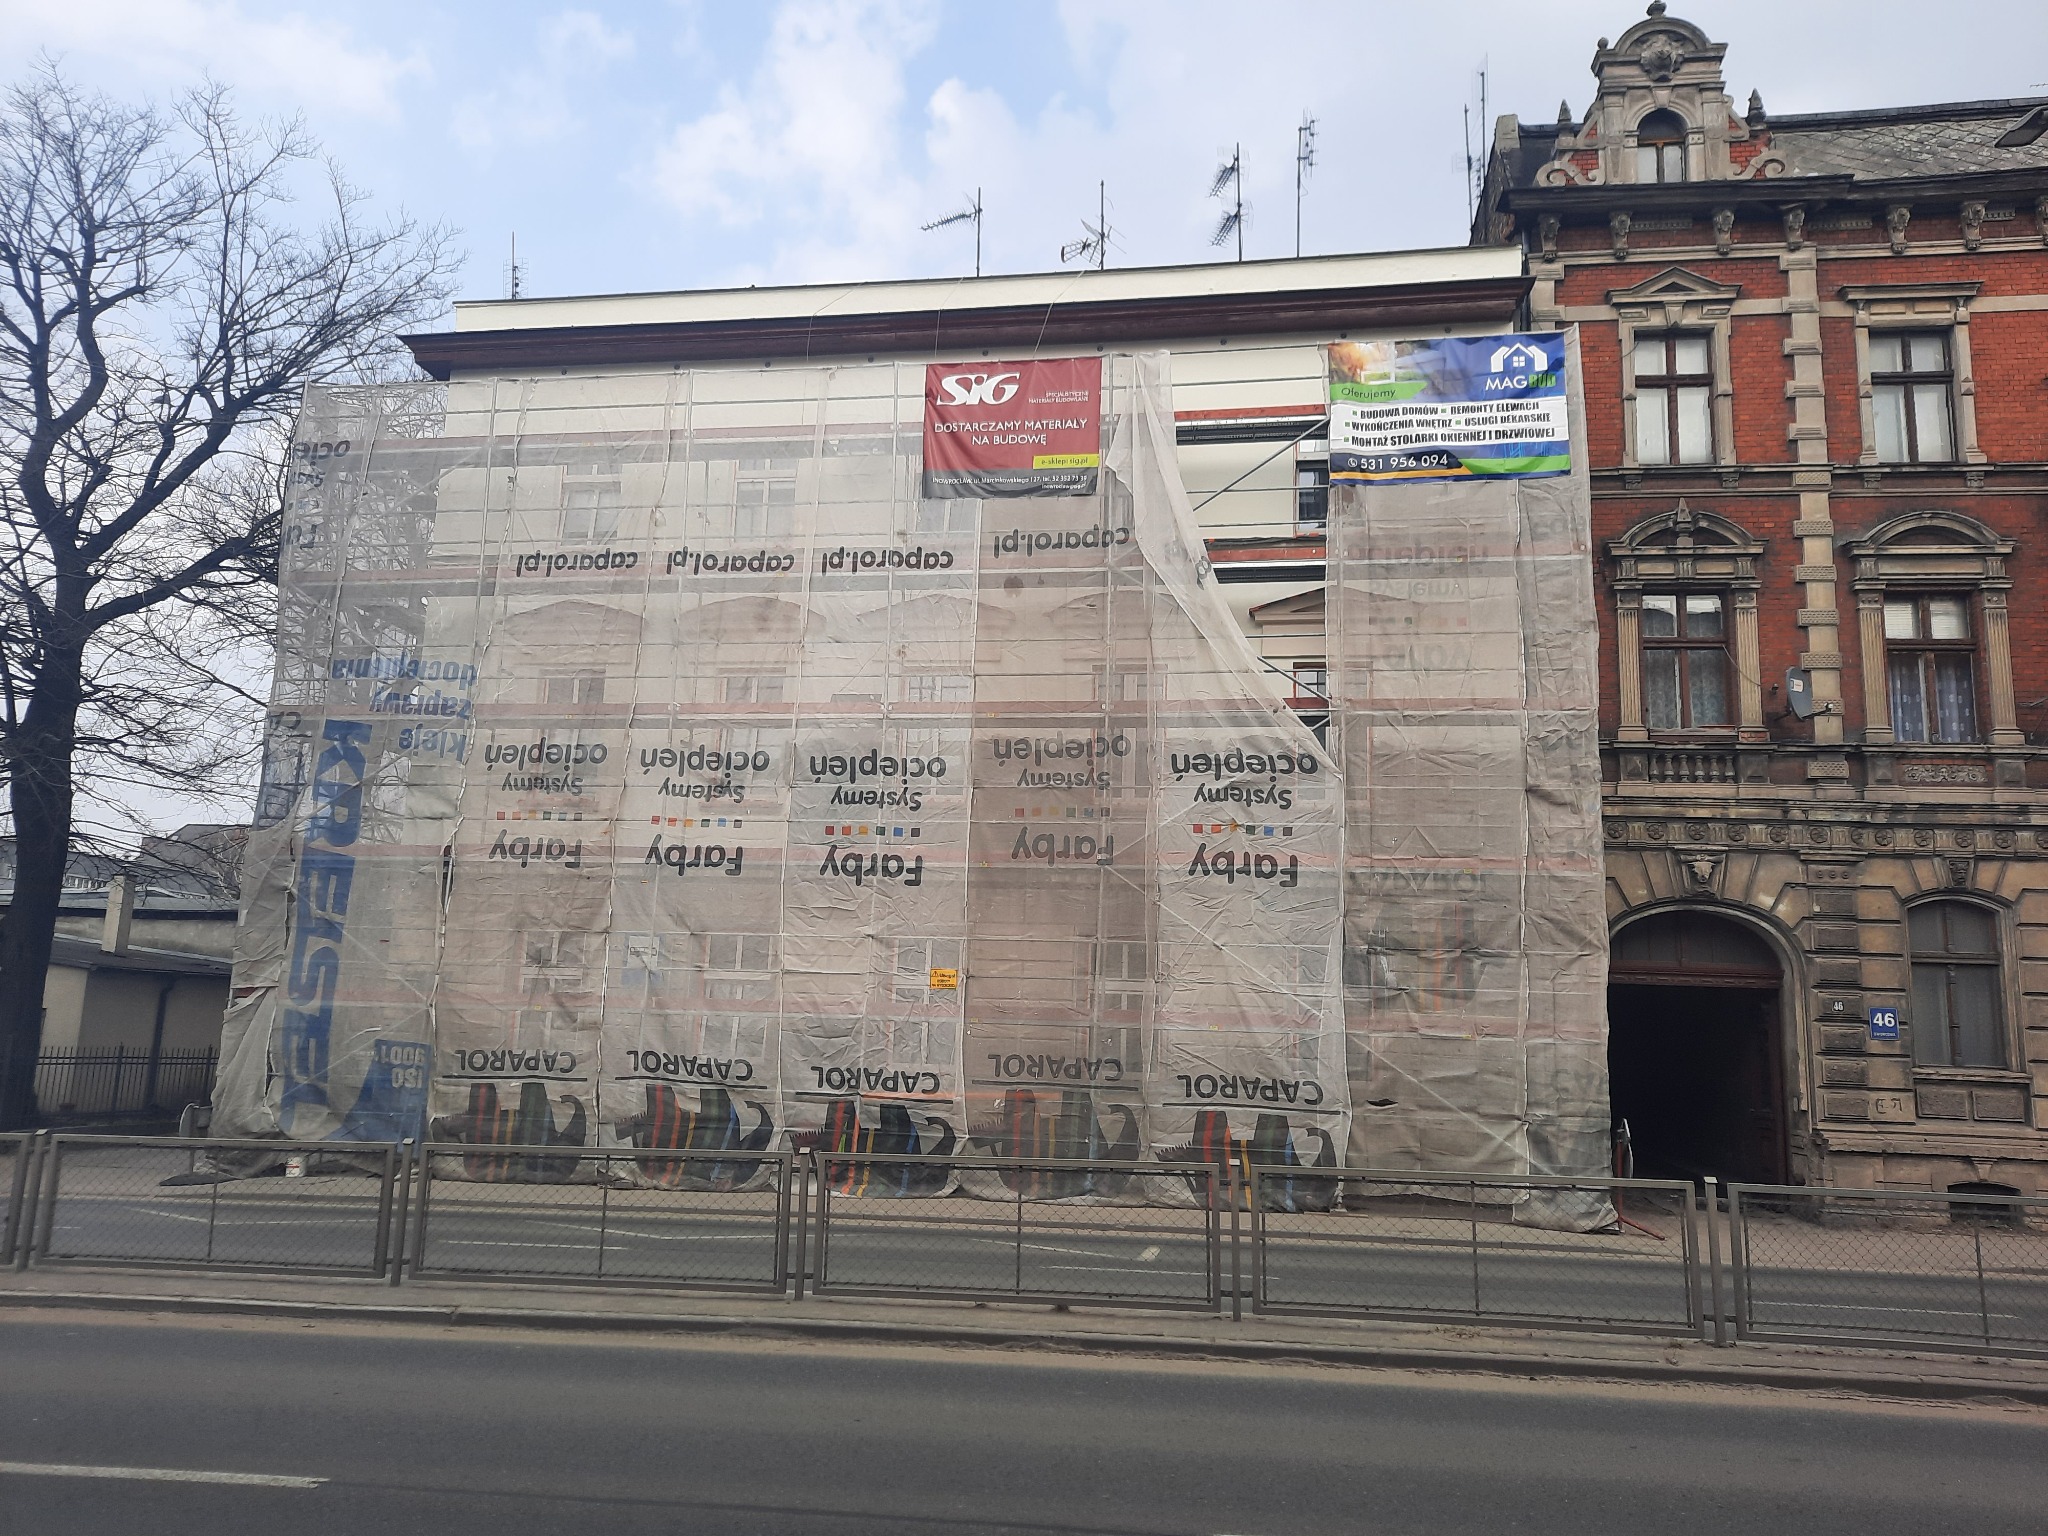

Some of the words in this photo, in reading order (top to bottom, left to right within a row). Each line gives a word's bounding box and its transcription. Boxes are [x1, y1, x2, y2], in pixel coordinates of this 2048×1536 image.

[1341, 387, 1396, 400] Oferujemy
[934, 420, 1021, 433] DOSTARCZAMY
[1024, 418, 1088, 431] MATERIAŁY
[1351, 418, 1414, 432] WYKOŃCZENIA
[1416, 418, 1452, 430] WNĘTRZ
[1500, 413, 1551, 424] DEKARSKIE
[1360, 407, 1400, 420] BUDOWA
[1401, 405, 1439, 416] DOMÓW
[1450, 404, 1494, 415] REMONTY
[1496, 402, 1540, 413] ELEWACJI
[972, 435, 990, 446] NA
[993, 434, 1047, 446] BUDOWĘ
[1351, 435, 1388, 447] MONTAŻ
[1390, 432, 1439, 446] STOLARKI
[1440, 430, 1486, 442] OKIENNEJ
[1494, 428, 1555, 440] DRZWIOWEJ
[1360, 458, 1383, 470] 531
[1390, 456, 1417, 468] 956
[1421, 454, 1448, 467] 094
[994, 524, 1130, 558] caparol.pl
[516, 547, 639, 577] caparol.pl
[666, 546, 795, 576] caparol.pl
[821, 546, 954, 576] caparol.pl
[399, 723, 466, 762] kleje
[484, 737, 608, 771] ociepleń
[992, 731, 1132, 766] ociepleń
[640, 744, 770, 779] ociepleń
[810, 748, 947, 785] ociepleń
[1171, 747, 1318, 782] ociepleń
[502, 772, 584, 796] Systemy
[658, 777, 745, 803] Systemy
[1017, 768, 1111, 791] Systemy
[830, 785, 923, 812] Systemy
[1194, 783, 1292, 810] Systemy
[489, 829, 582, 868] Farby
[645, 833, 743, 876] Farby
[1011, 826, 1114, 867] Farby
[819, 844, 923, 886] Farby
[1188, 843, 1298, 887] Farby
[1833, 1002, 1844, 1011] 46
[1873, 1012, 1895, 1027] 46
[455, 1048, 577, 1074] CAPAROL
[626, 1050, 753, 1082] CAPAROL
[988, 1054, 1125, 1082] CAPAROL
[391, 1068, 422, 1088] ISO
[810, 1065, 941, 1094] CAPAROL
[1176, 1074, 1324, 1106] CAPAROL
